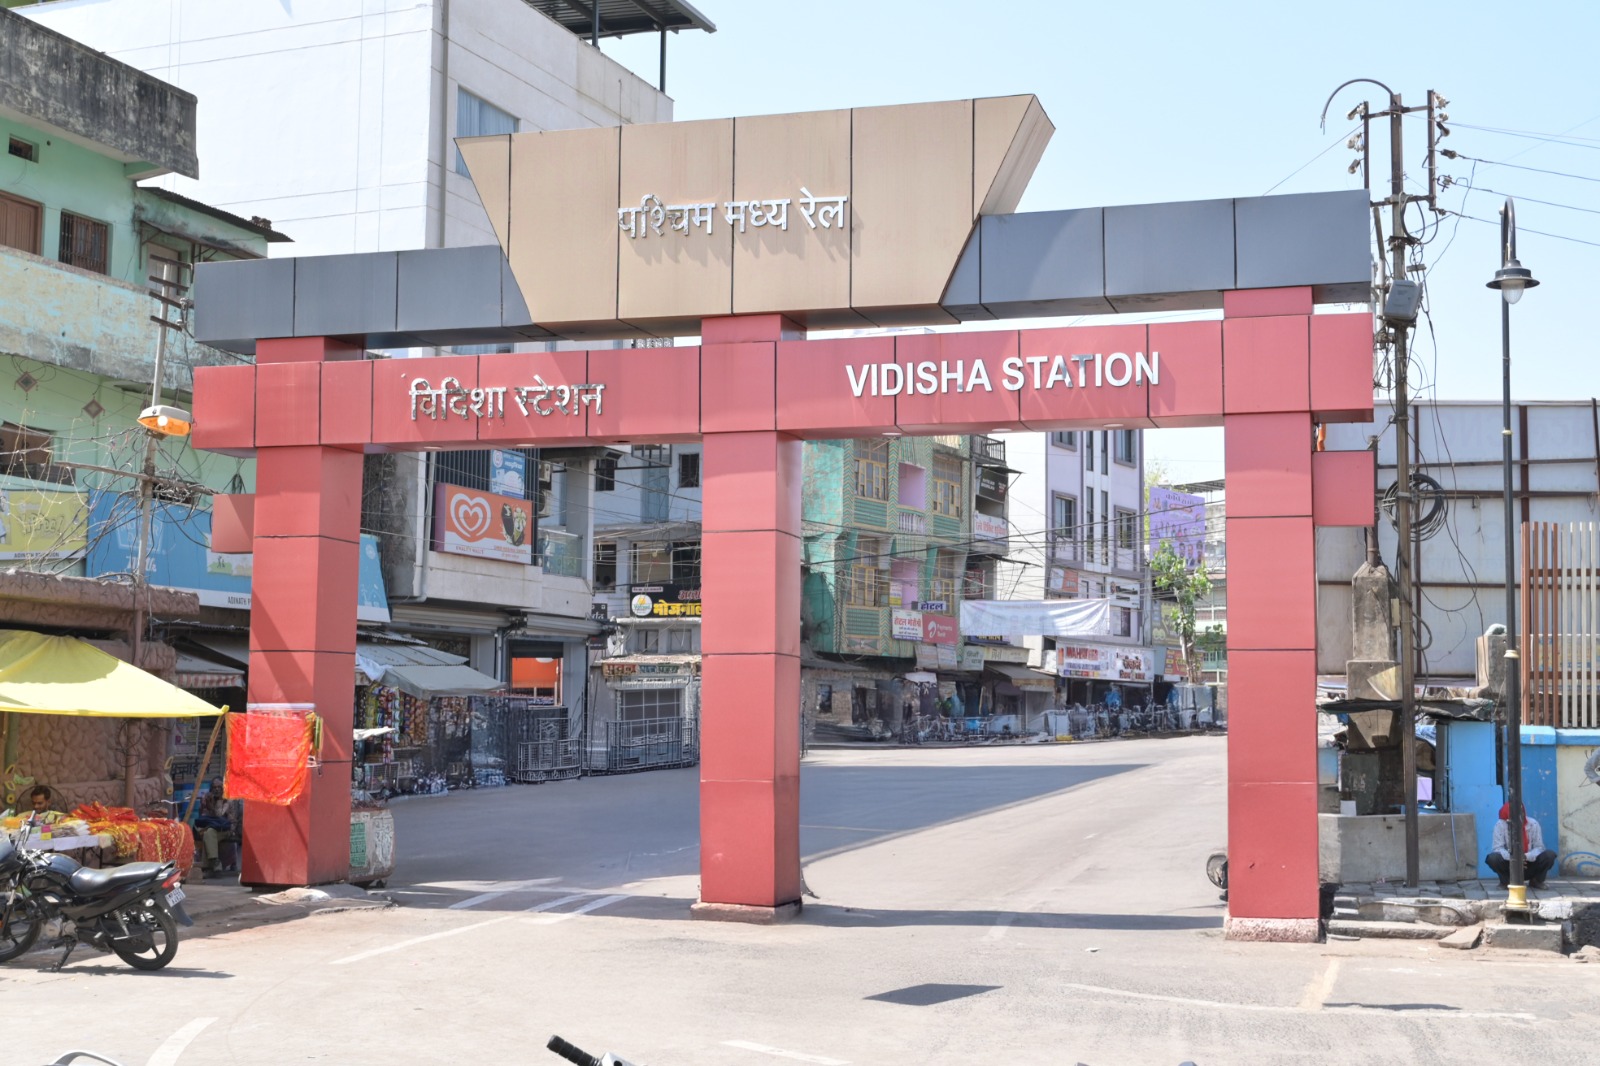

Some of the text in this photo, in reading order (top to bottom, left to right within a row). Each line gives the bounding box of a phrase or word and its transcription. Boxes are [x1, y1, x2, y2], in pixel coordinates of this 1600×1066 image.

[617, 187, 848, 238] पश्चिम मध्य रेल
[845, 351, 1159, 397] VIDISHA STATION
[408, 374, 606, 421] विदिशा स्टेशन
[920, 600, 944, 611] होटल
